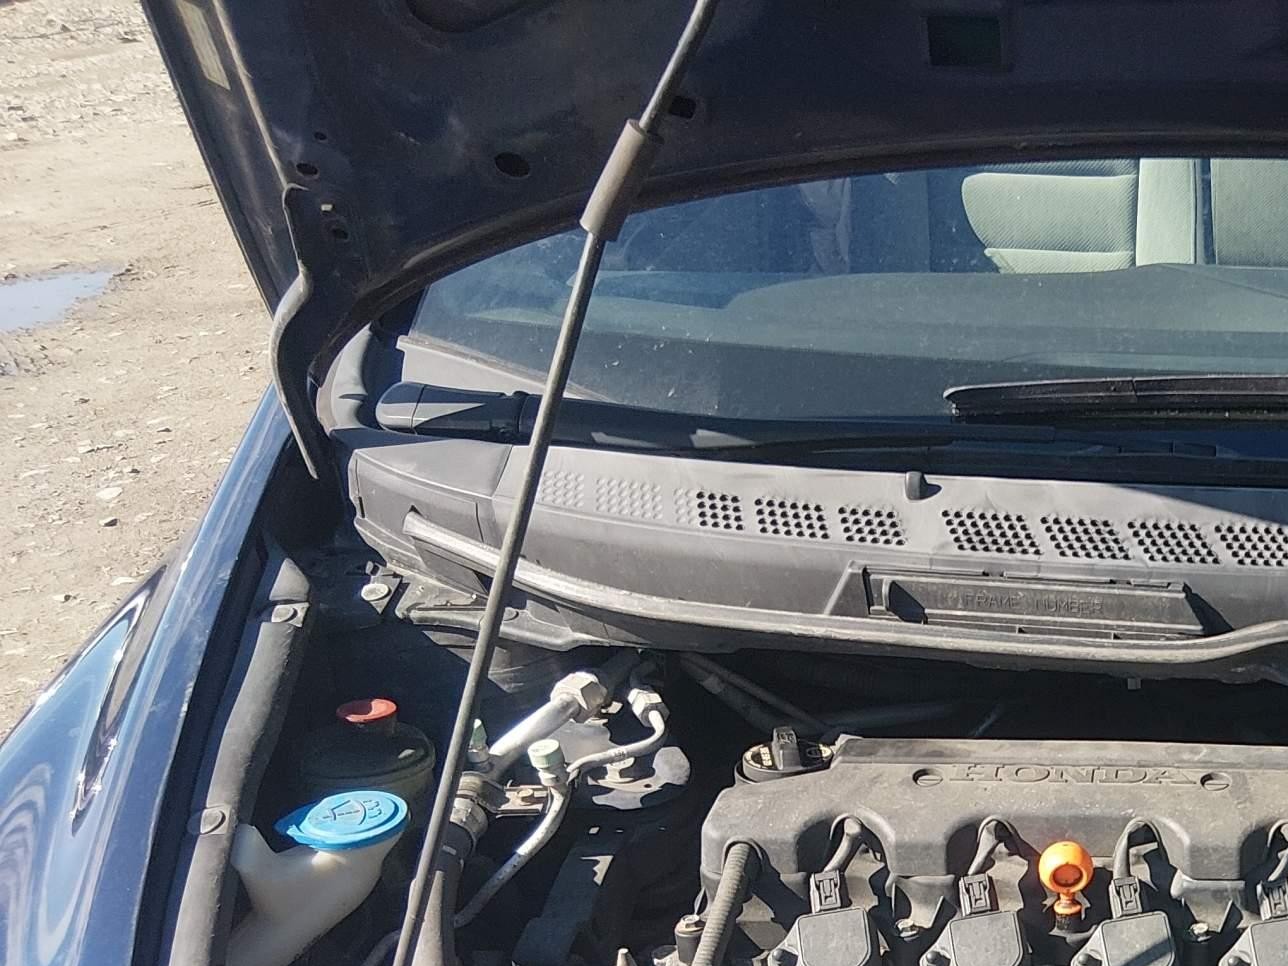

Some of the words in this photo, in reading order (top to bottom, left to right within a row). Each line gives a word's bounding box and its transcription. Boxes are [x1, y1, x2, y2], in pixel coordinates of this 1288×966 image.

[963, 591, 1021, 609] FRAME
[1034, 596, 1104, 615] NUMBER
[949, 763, 1197, 786] HONDA
